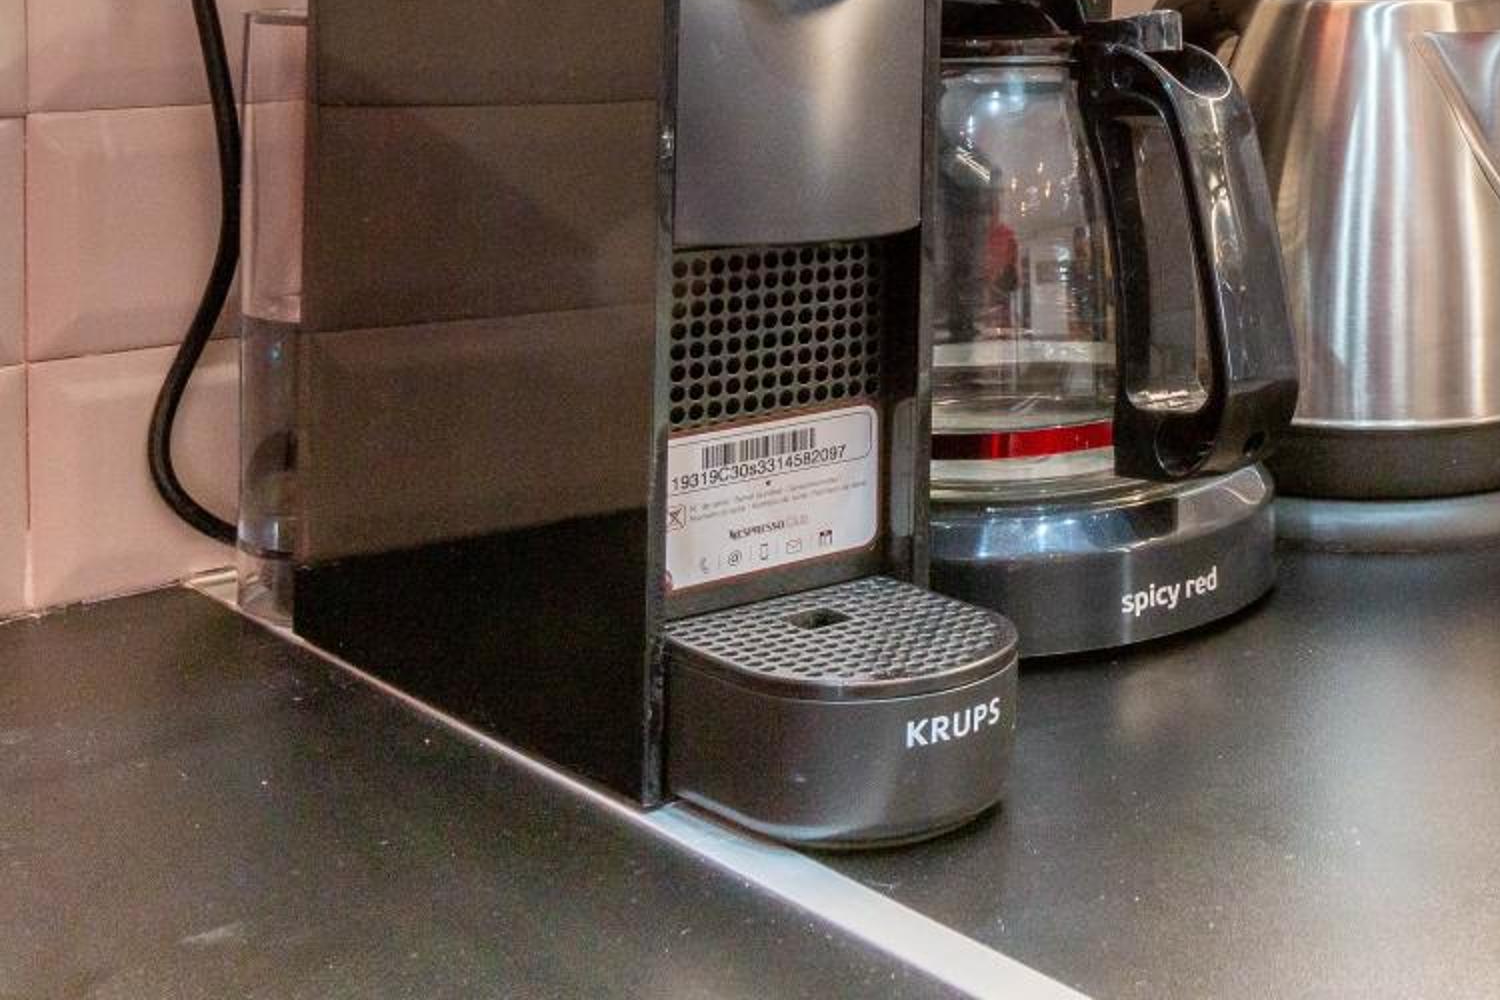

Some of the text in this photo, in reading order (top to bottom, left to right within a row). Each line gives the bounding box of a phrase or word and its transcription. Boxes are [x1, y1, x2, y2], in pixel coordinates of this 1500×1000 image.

[1121, 565, 1217, 617] spicy red
[906, 697, 1000, 749] KRUPS
